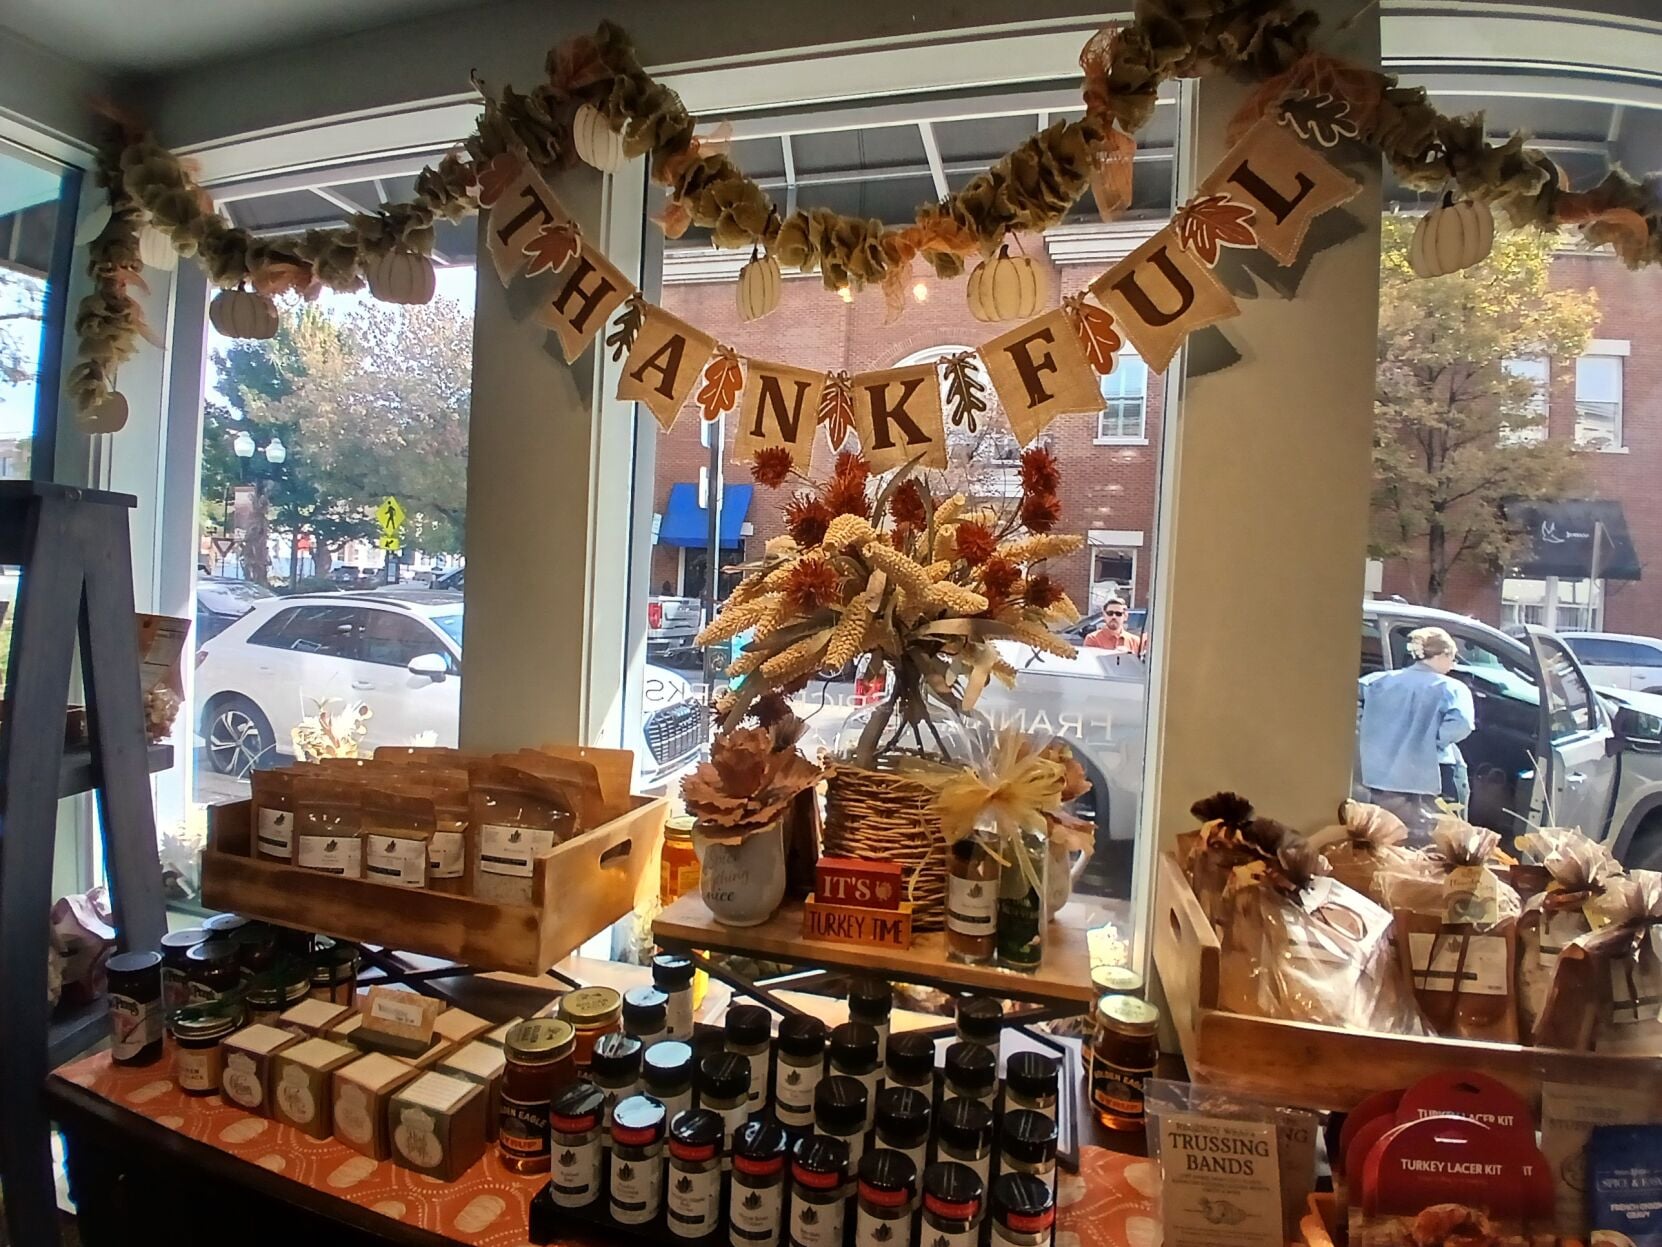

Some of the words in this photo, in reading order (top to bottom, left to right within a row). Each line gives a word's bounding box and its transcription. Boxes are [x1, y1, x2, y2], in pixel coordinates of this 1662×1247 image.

[497, 159, 1315, 450] THANKFUL
[823, 876, 871, 900] IT'S
[810, 911, 865, 938] TURKEY
[872, 917, 903, 944] TIME
[518, 1110, 547, 1128] EAGLE
[1497, 1115, 1515, 1126] KIT
[1168, 1132, 1270, 1157] TRUSSING
[1186, 1154, 1255, 1176] BANDS
[1401, 1158, 1445, 1172] TURKEY
[1447, 1162, 1483, 1174] LACER
[1484, 1164, 1503, 1175] KIT
[1522, 1165, 1534, 1176] IT
